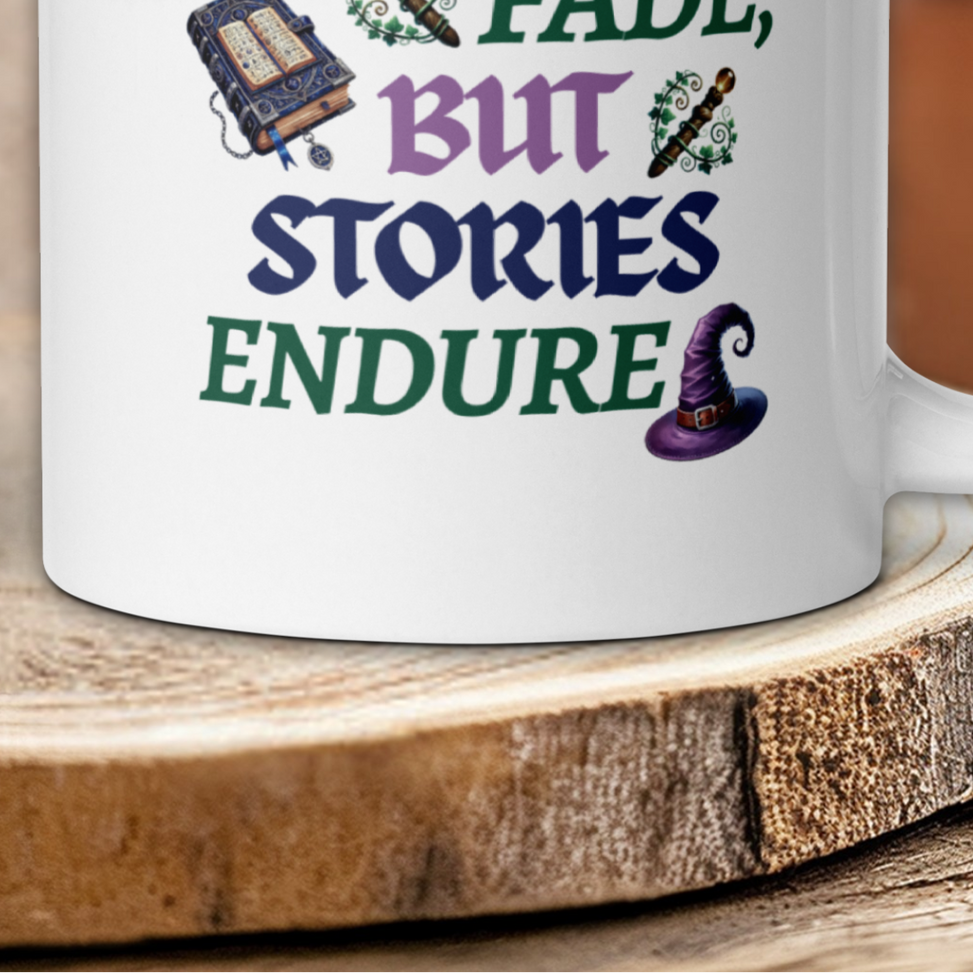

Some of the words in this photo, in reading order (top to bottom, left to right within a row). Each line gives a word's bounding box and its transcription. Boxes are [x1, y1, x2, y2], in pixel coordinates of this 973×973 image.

[377, 70, 634, 176] BUT
[247, 190, 720, 302] STORIES
[199, 316, 672, 417] ENDURE
